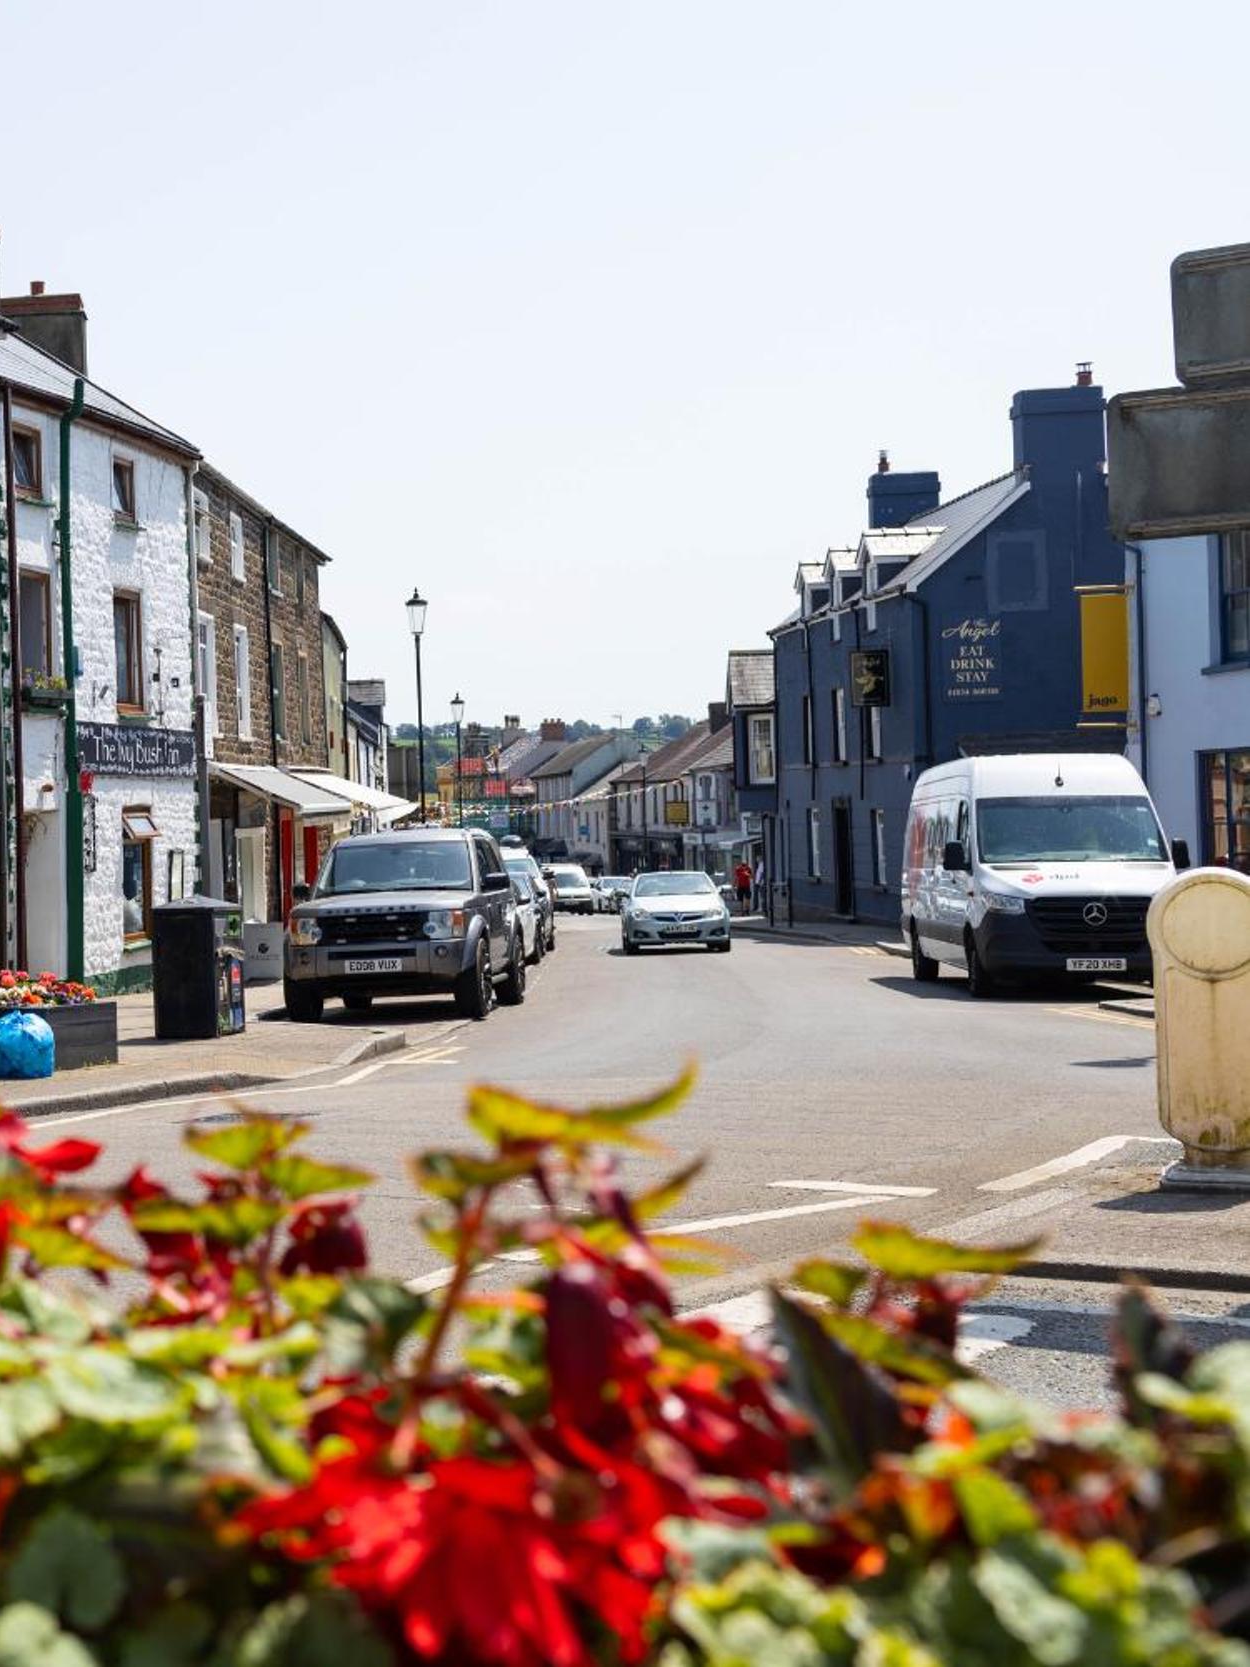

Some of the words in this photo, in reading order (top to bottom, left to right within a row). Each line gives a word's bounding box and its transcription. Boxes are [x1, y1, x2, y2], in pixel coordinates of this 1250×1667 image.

[941, 619, 1002, 642] Angel
[959, 646, 983, 656] EAT
[951, 658, 995, 669] DRINK
[956, 671, 989, 682] STAY
[93, 726, 116, 761] The
